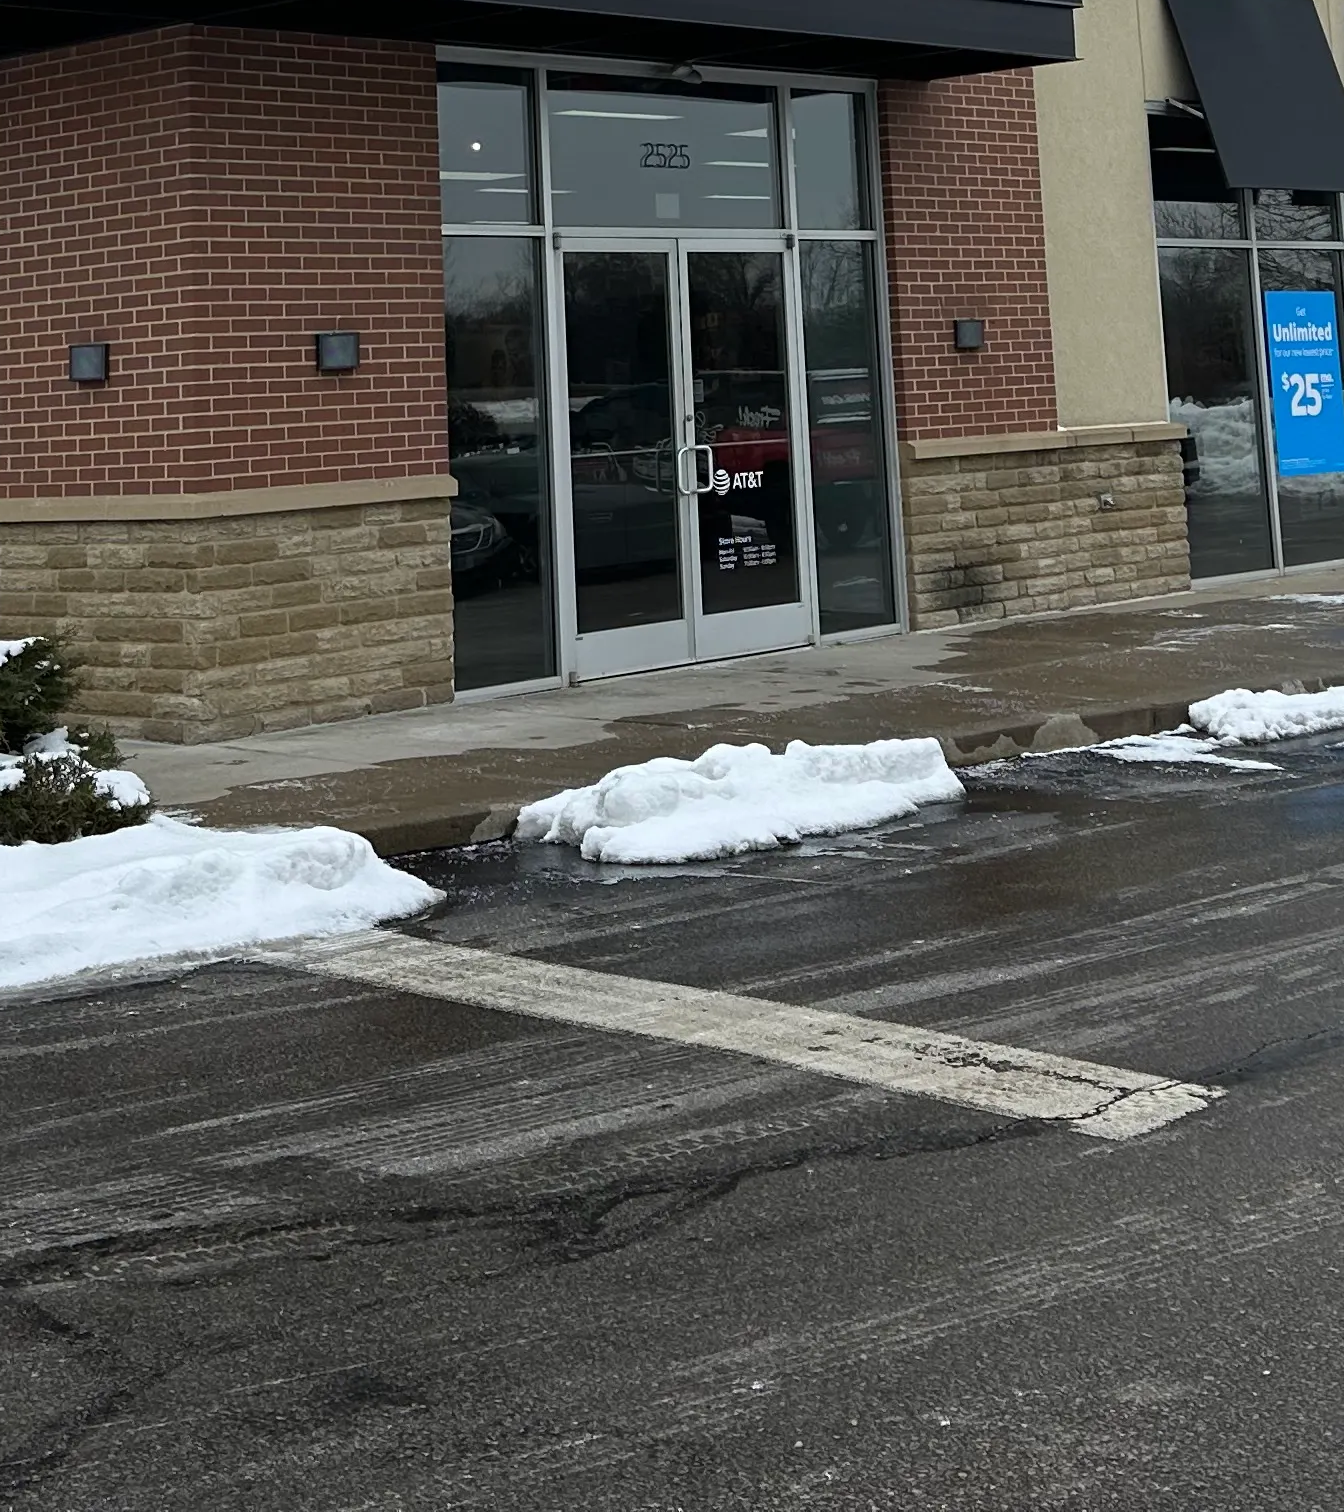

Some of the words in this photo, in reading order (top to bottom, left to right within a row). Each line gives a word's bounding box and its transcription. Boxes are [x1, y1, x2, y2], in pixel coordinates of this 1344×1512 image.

[641, 142, 690, 169] 2525
[1272, 322, 1333, 342] Unlimited
[1281, 371, 1323, 418] $25
[732, 471, 764, 490] AT&T
